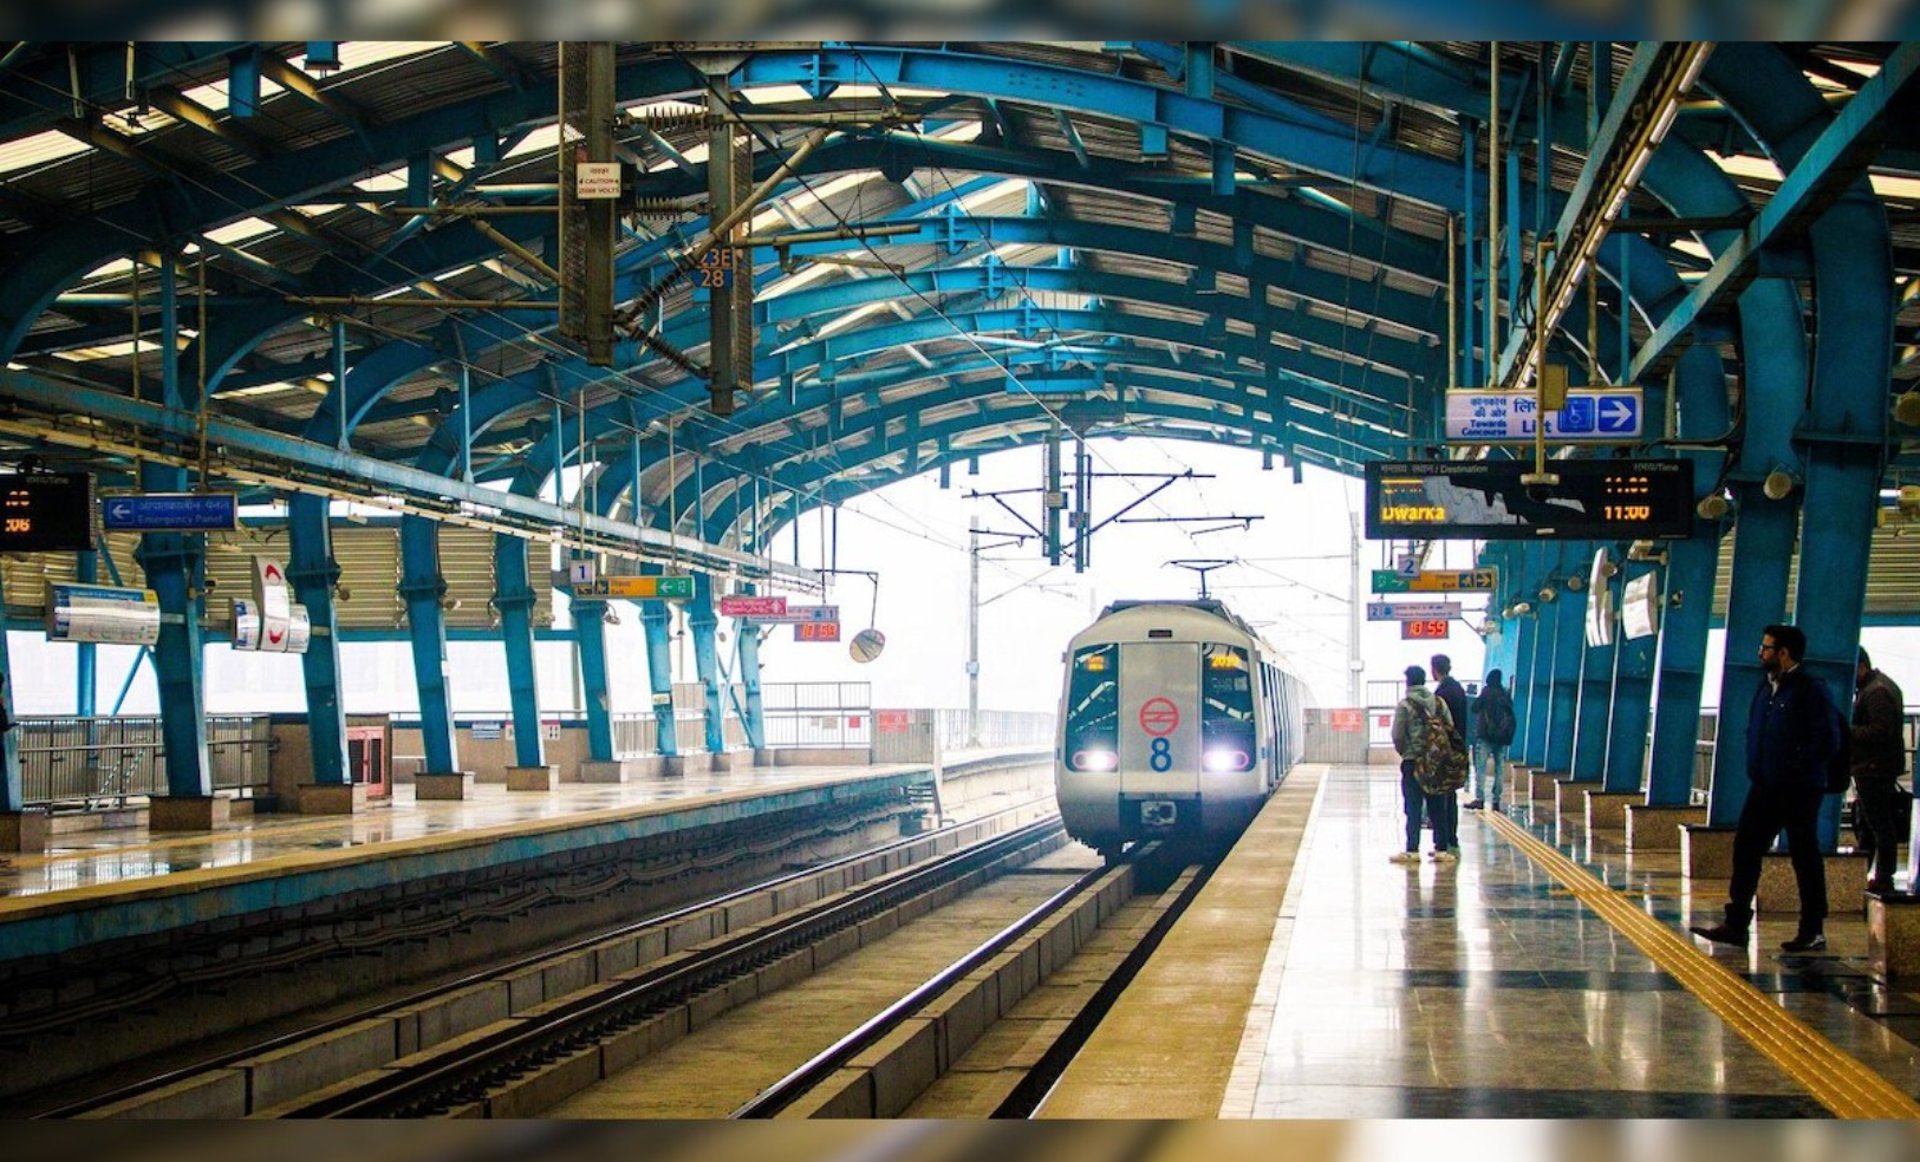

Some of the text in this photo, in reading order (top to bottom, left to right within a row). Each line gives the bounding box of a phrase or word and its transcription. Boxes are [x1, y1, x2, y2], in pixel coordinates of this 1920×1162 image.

[701, 269, 724, 287] 28
[1462, 427, 1507, 436] Concourse
[1470, 419, 1552, 433] Towards Lit
[137, 514, 223, 525] Emergency Panel
[1381, 506, 1446, 520] Dwarka
[1604, 506, 1650, 520] 11:00
[578, 565, 585, 580] 1
[1404, 560, 1414, 574] 2
[1150, 737, 1173, 773] 8
